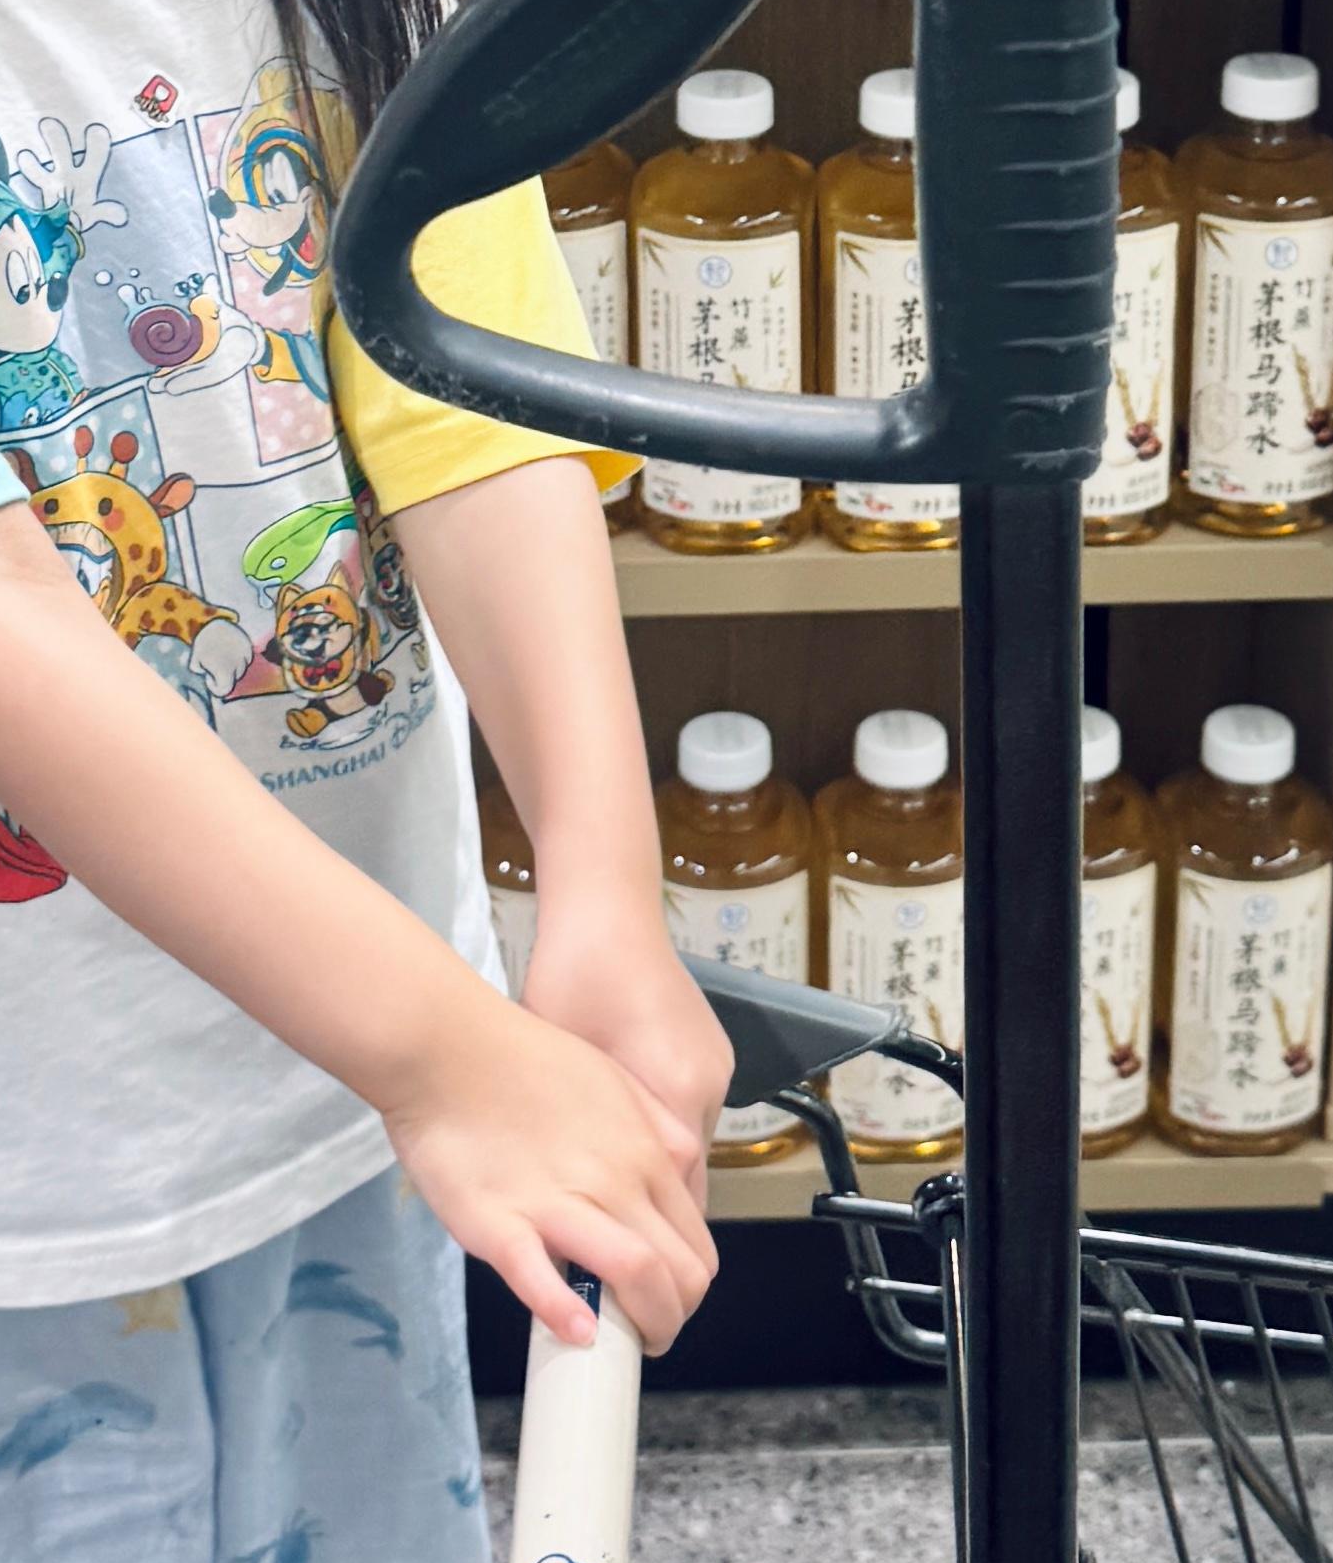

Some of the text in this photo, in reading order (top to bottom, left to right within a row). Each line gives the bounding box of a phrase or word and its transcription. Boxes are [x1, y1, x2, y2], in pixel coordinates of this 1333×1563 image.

[1244, 279, 1285, 455] 茅根马蹄水
